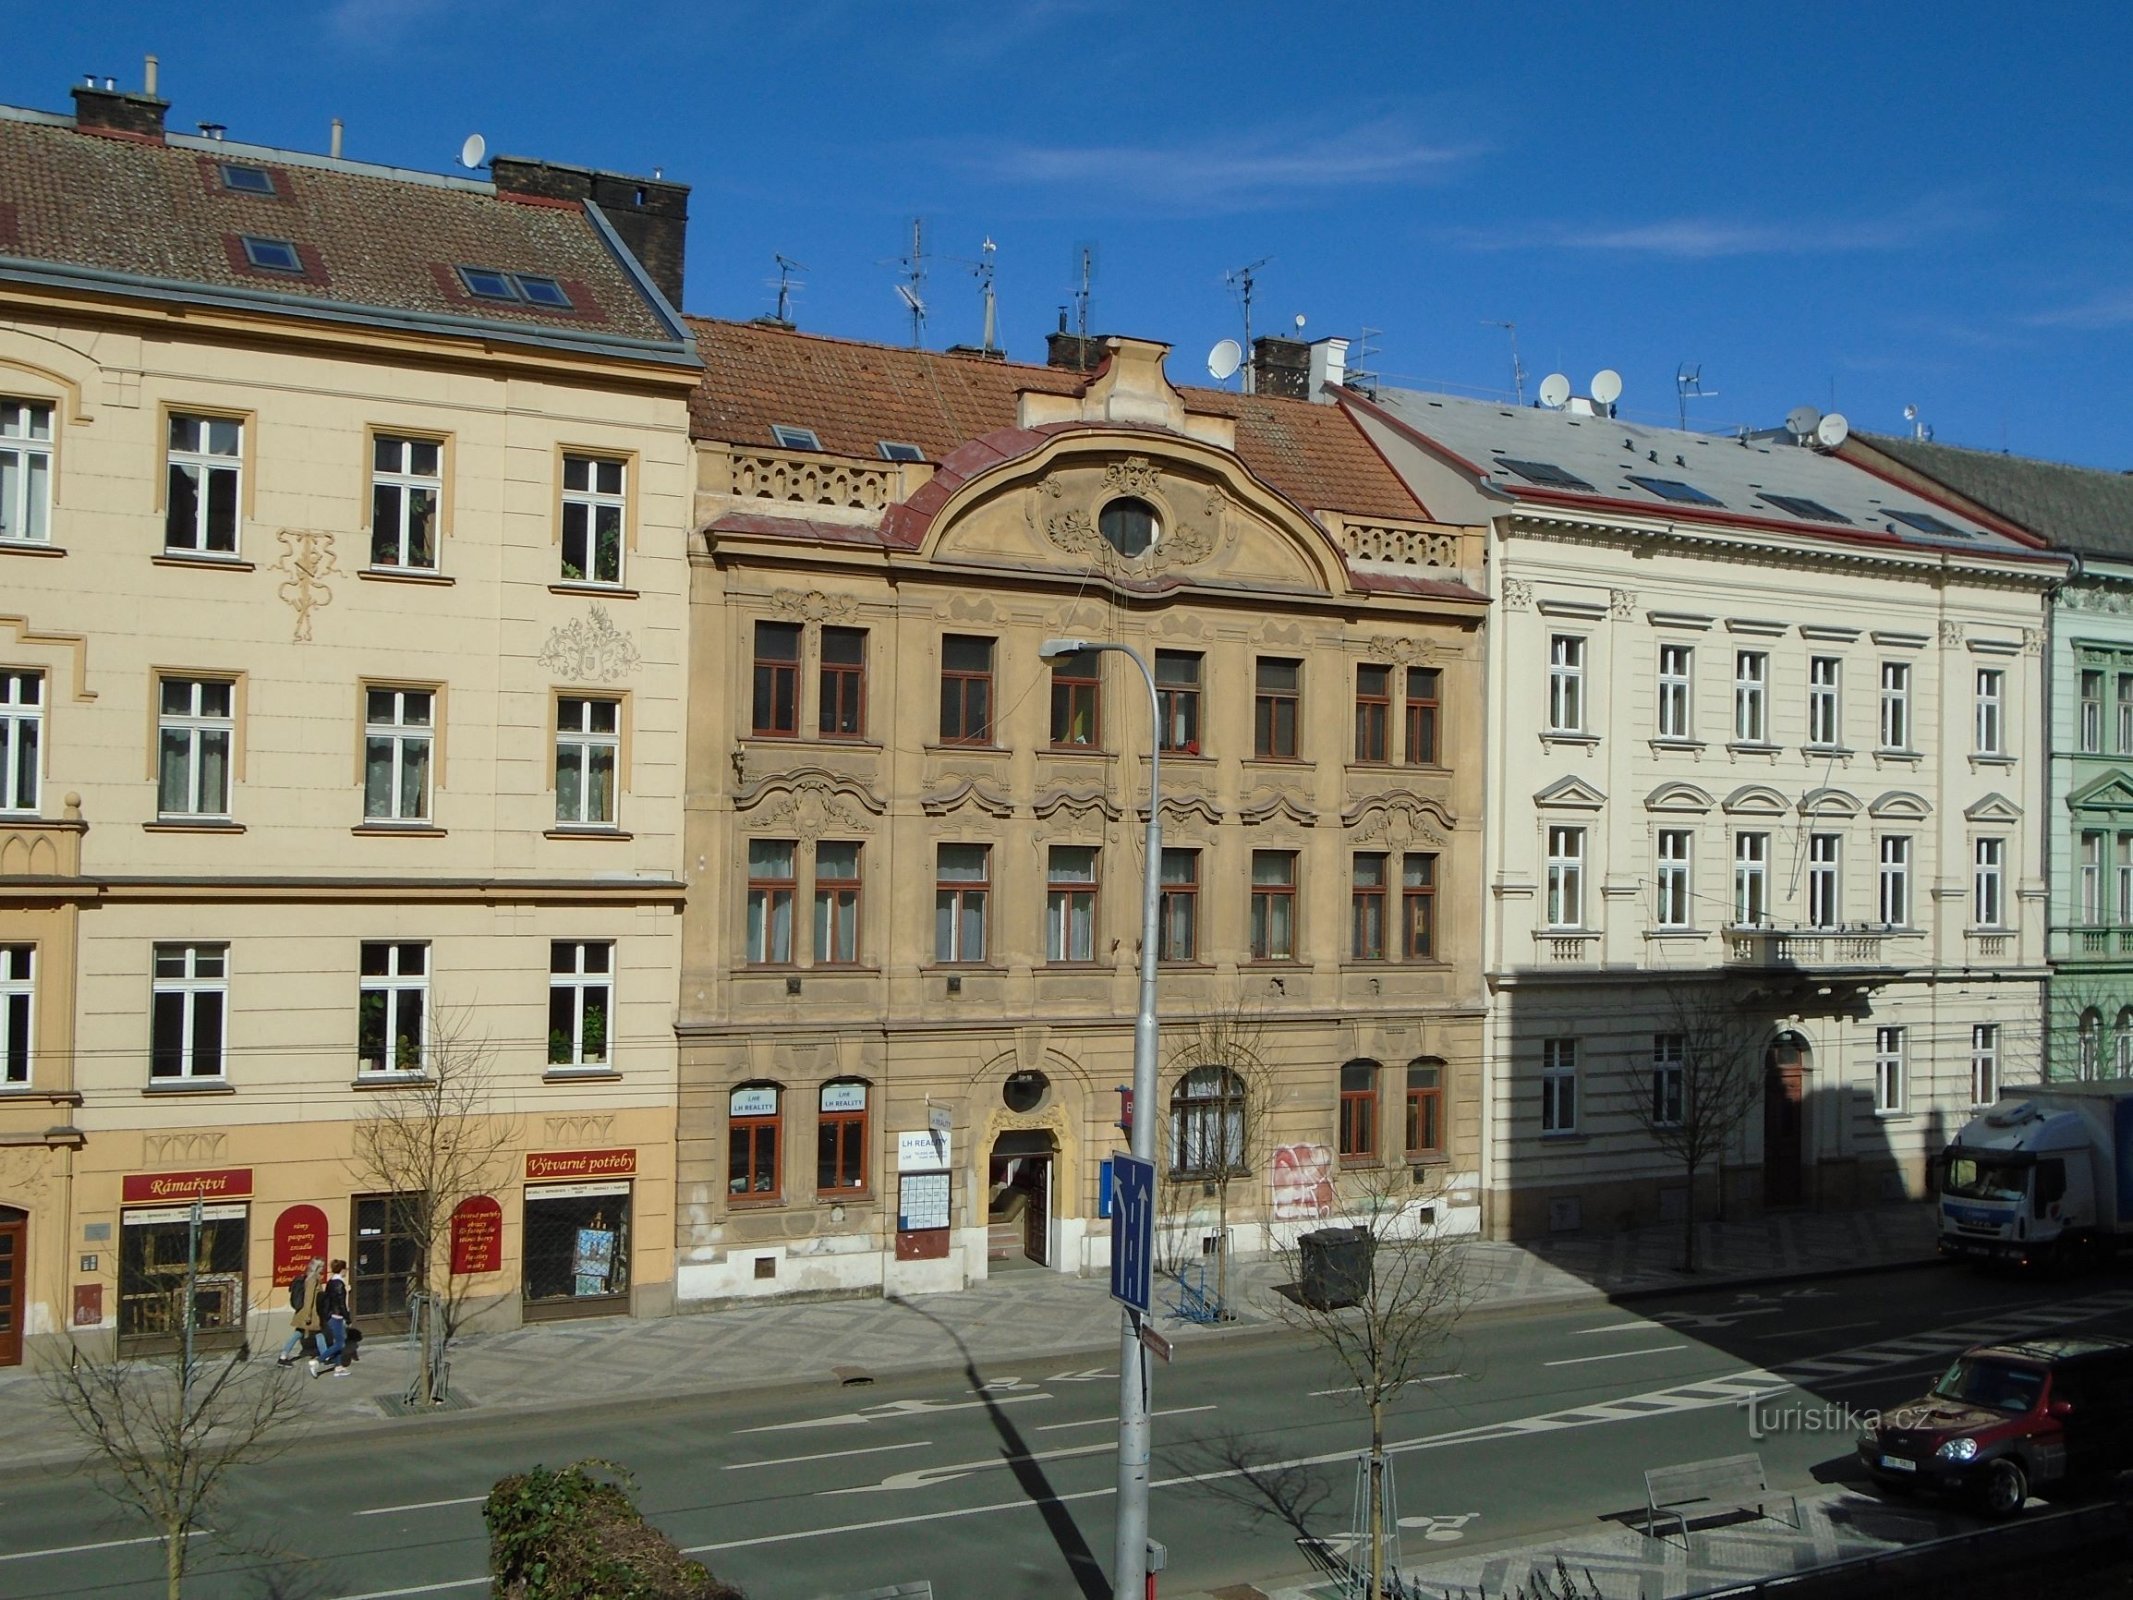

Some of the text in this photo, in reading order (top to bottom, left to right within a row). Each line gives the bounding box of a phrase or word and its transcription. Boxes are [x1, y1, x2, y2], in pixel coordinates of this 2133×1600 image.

[835, 1099, 862, 1107] REALITY
[914, 1138, 948, 1147] REALITY
[528, 1153, 634, 1175] Výtvarné potřeby
[150, 1176, 228, 1195] Rámařství
[293, 1222, 310, 1231] rámy
[287, 1233, 315, 1242] pasparty
[289, 1242, 313, 1251] zrcadla
[290, 1254, 312, 1263] plátna
